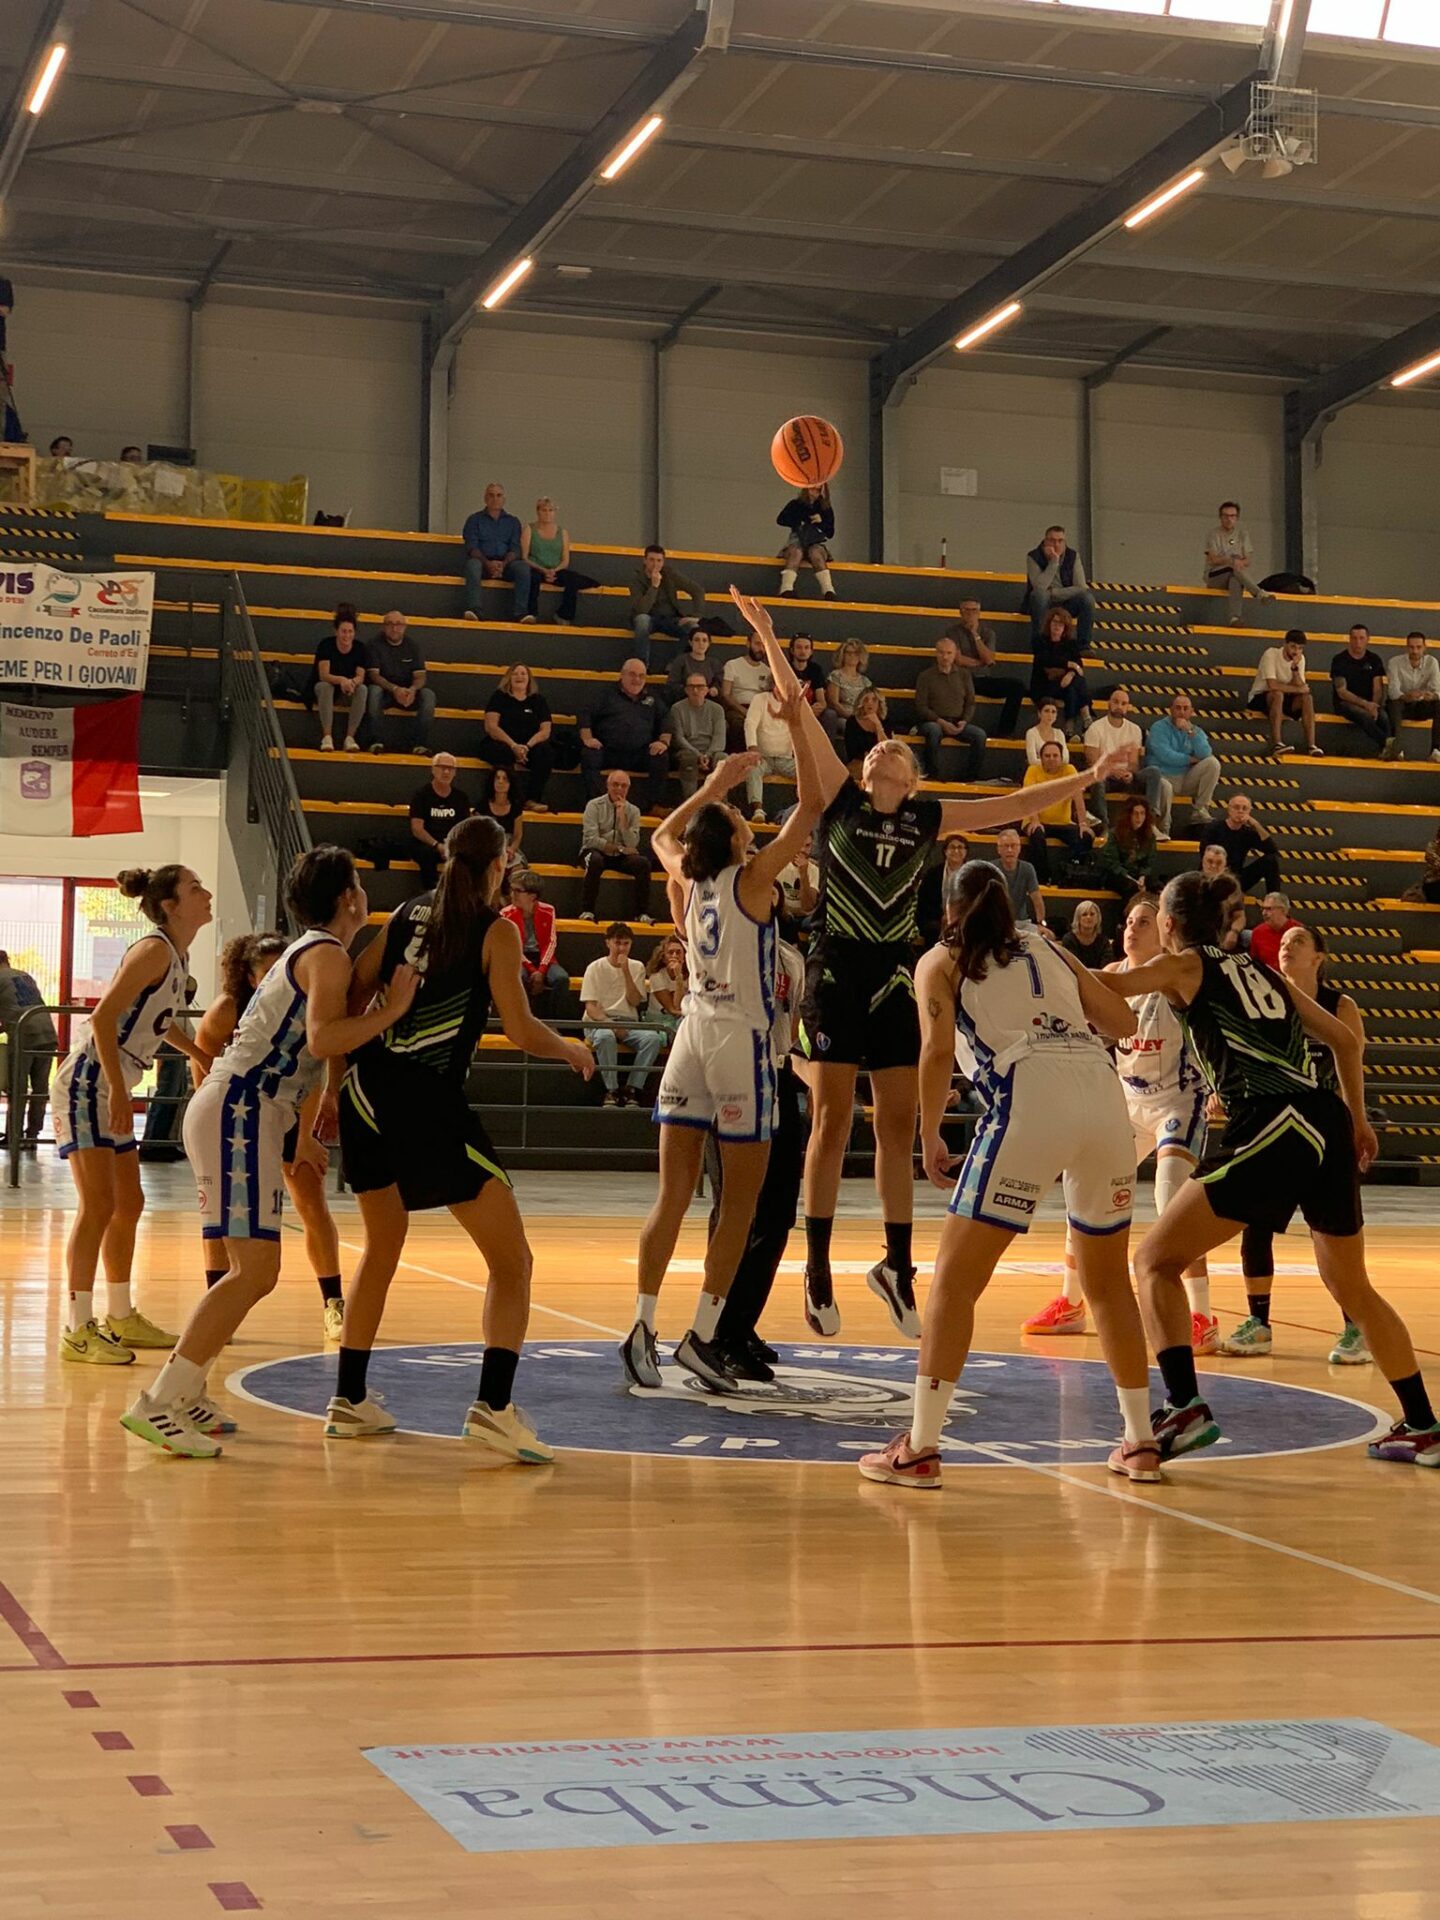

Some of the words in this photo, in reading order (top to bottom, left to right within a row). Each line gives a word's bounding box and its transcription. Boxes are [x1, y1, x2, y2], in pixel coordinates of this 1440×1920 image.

[0, 626, 63, 642] ncenzo
[69, 627, 93, 644] De
[98, 628, 141, 646] Paoli
[34, 660, 62, 680] PER
[68, 664, 73, 681] I
[79, 664, 137, 685] GIOVANI
[5, 705, 54, 720] MEMENTO
[19, 727, 58, 739] AUDERE
[31, 745, 69, 757] SEMPER
[430, 807, 455, 817] HWPO
[856, 827, 915, 847] Passalacqua
[876, 843, 896, 868] 17
[699, 906, 720, 959] 3
[1219, 957, 1286, 1019] 18
[995, 1195, 1029, 1209] ARMA
[671, 1435, 780, 1450] di
[389, 1737, 785, 1761] www.chemiba.it
[607, 1745, 1004, 1768] info@chemiba.it
[669, 1769, 884, 1782] GENOVA
[443, 1770, 1166, 1836] Chemiba
